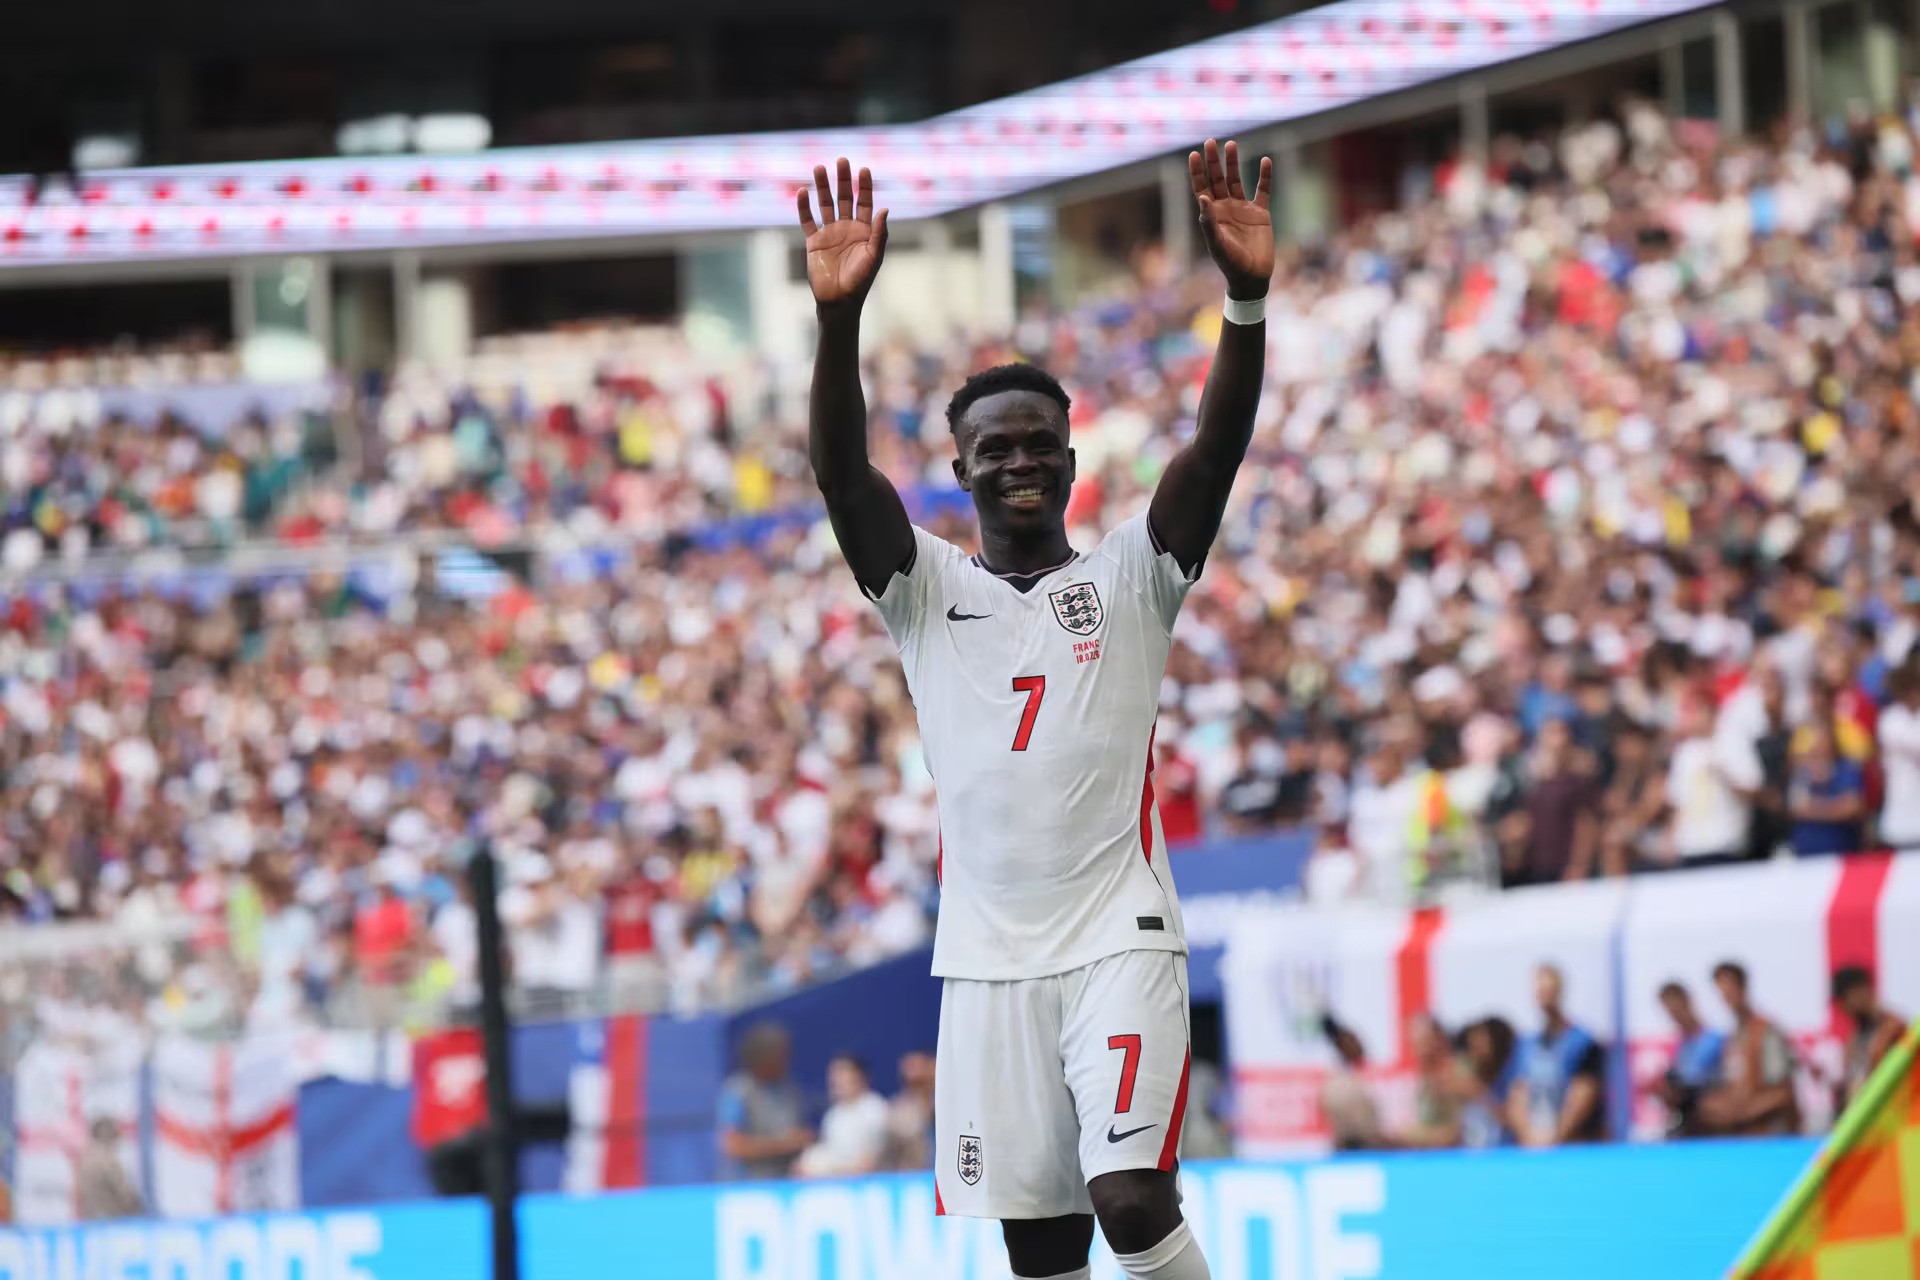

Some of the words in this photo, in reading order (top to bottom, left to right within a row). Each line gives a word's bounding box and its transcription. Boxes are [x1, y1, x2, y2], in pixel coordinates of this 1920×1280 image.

[1072, 638, 1100, 653] FRANC
[1011, 675, 1045, 751] 7
[1107, 1034, 1141, 1114] 7
